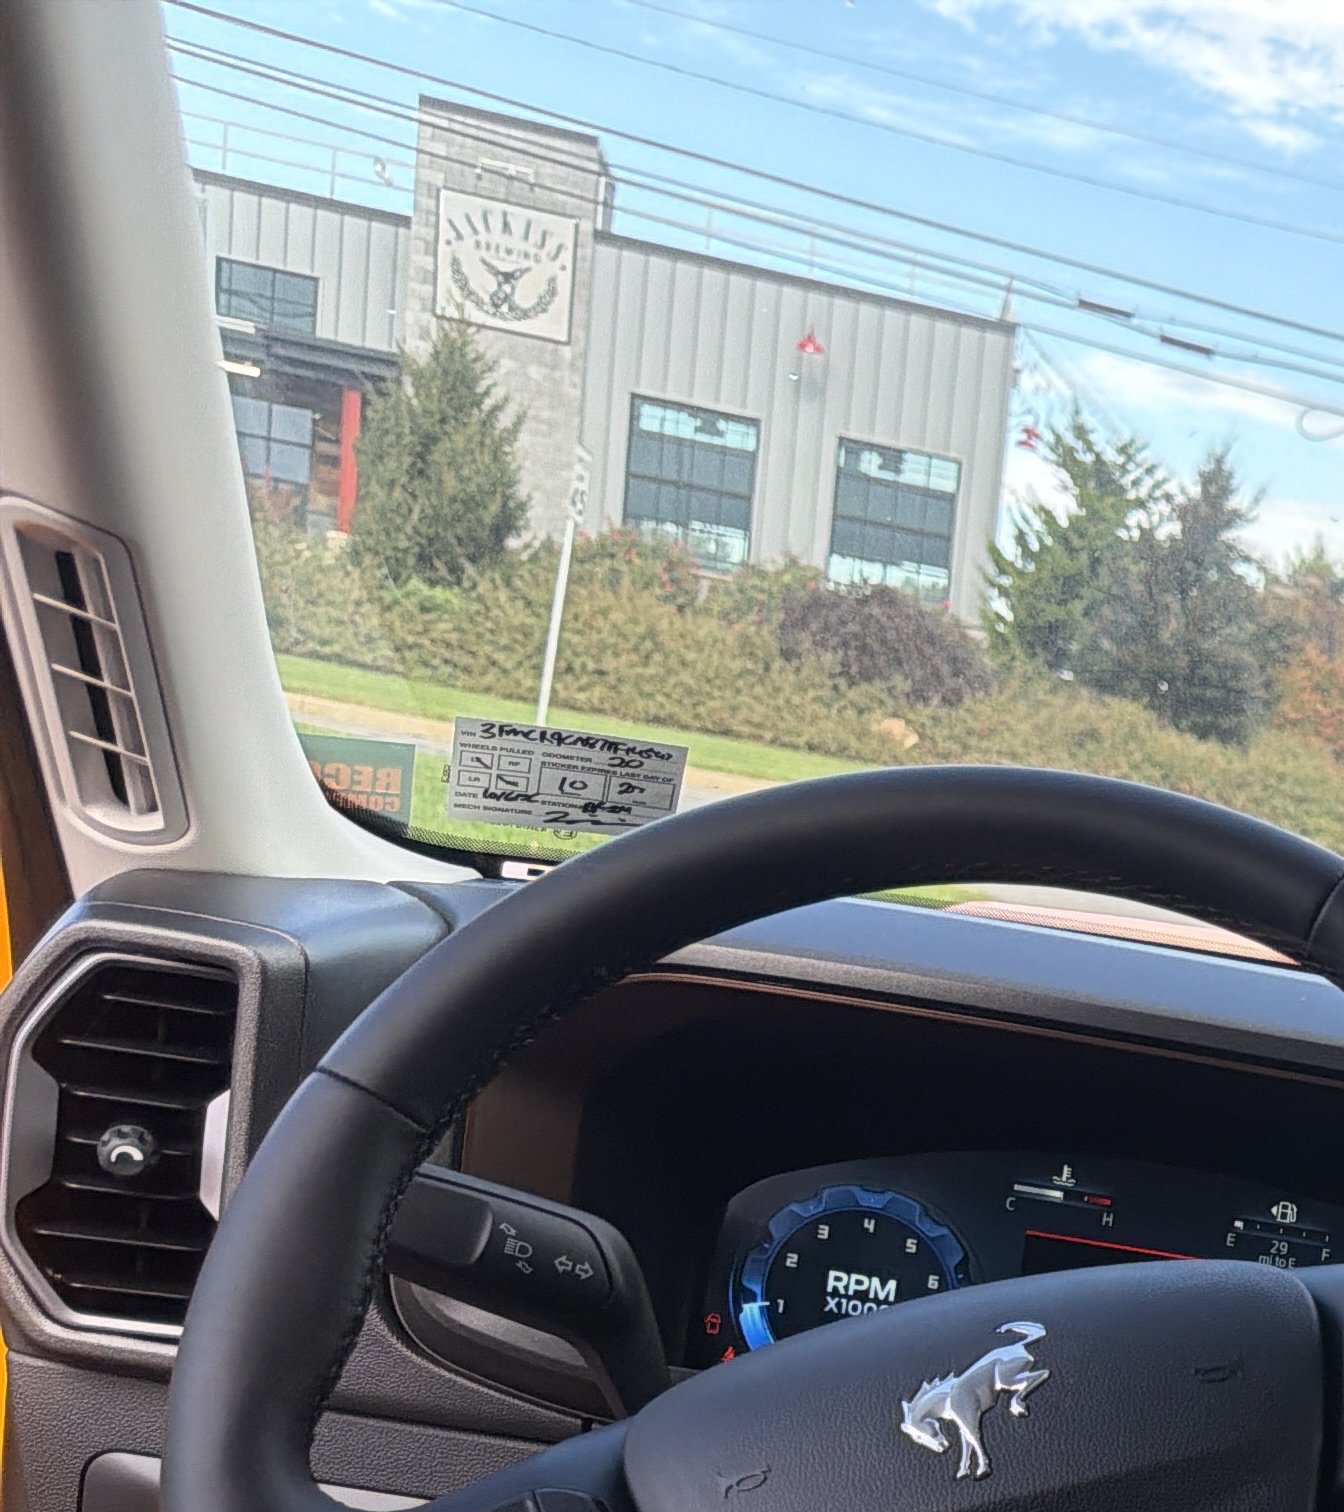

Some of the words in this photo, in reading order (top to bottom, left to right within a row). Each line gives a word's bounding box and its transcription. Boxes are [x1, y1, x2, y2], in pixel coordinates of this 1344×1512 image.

[607, 756, 645, 769] 20
[1005, 1198, 1016, 1211] C
[864, 1218, 876, 1233] 4
[1102, 1212, 1114, 1227] H
[817, 1225, 830, 1240] 3
[1226, 1233, 1237, 1247] E
[905, 1238, 918, 1253] 5
[1270, 1240, 1289, 1255] 29
[785, 1253, 798, 1268] 2
[1275, 1255, 1287, 1268] to
[1288, 1258, 1296, 1269] E
[1321, 1248, 1331, 1261] F
[826, 1270, 897, 1302] RPM
[927, 1275, 940, 1290] 6
[776, 1299, 785, 1314] 1
